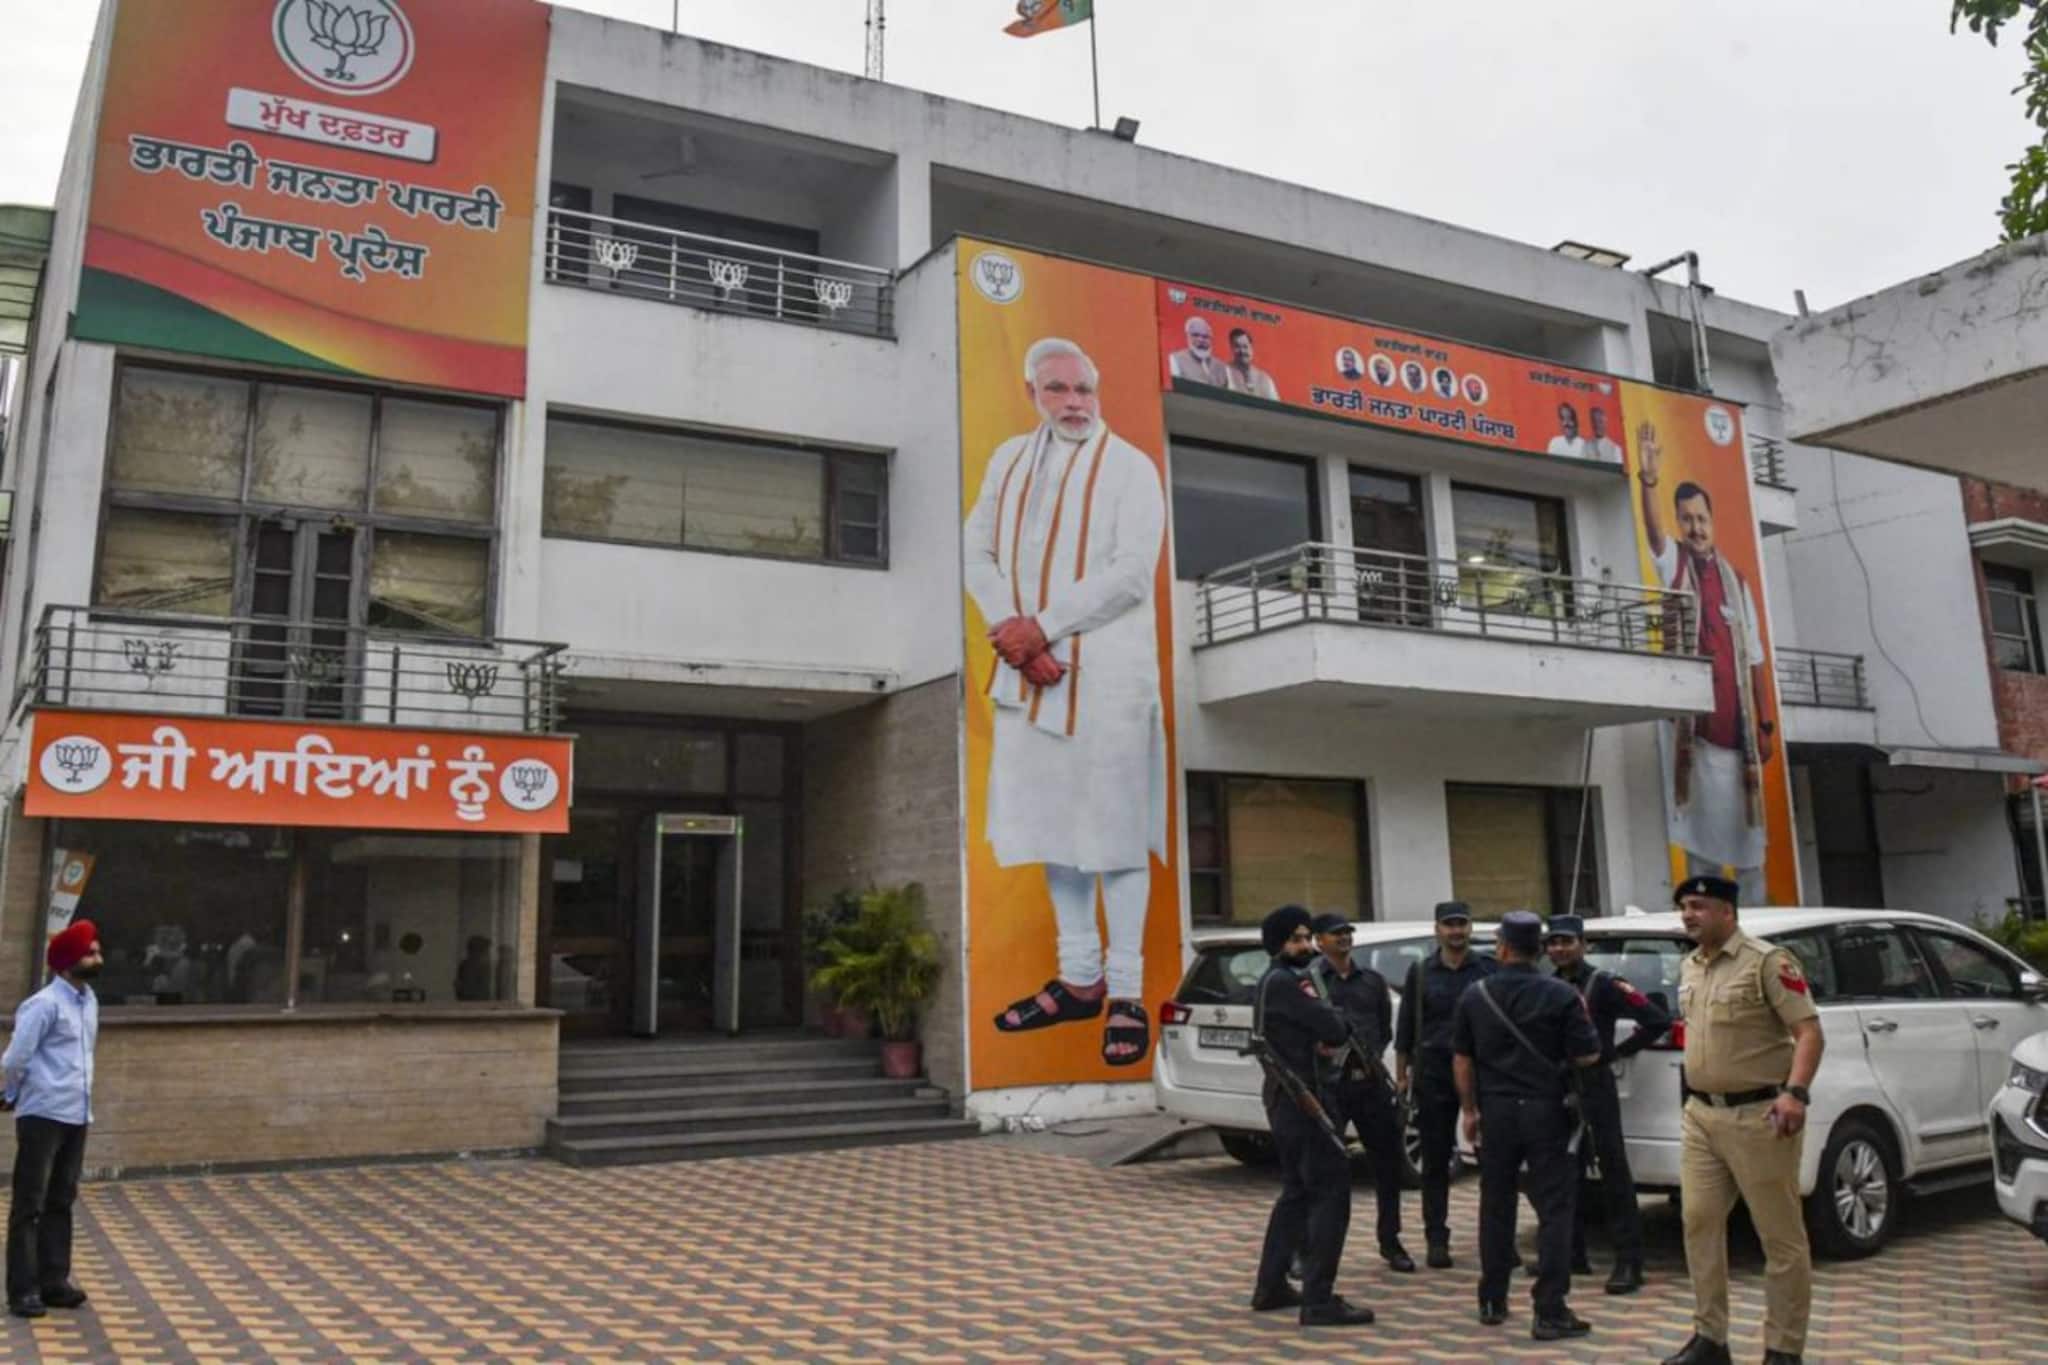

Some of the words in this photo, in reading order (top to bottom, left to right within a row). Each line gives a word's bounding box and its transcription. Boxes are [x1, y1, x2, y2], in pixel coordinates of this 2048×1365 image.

[259, 96, 310, 131] ਮੁੱਖ
[317, 113, 410, 149] ਦਫ਼ਤਰ
[129, 136, 259, 187] ਭਾਰਤੀ
[268, 160, 380, 204] ਜਨਤਾ
[388, 182, 504, 229] ਪਾਰਟੀ
[203, 204, 321, 260] ਪੰਜਾਬ
[329, 227, 428, 281] ਪ੍ਰਦੇਸ਼
[1312, 387, 1363, 411] ਭਾਰਤੀ
[1369, 398, 1413, 420] ਜਨਤਾ
[1418, 407, 1466, 431] ਪਾਰਟੀ
[1472, 412, 1516, 439] ਪੰਜਾਬ
[118, 725, 196, 791] ਜੀ
[208, 734, 436, 800] ਆਇਆਂ
[447, 745, 496, 822] ਨੂੰ
